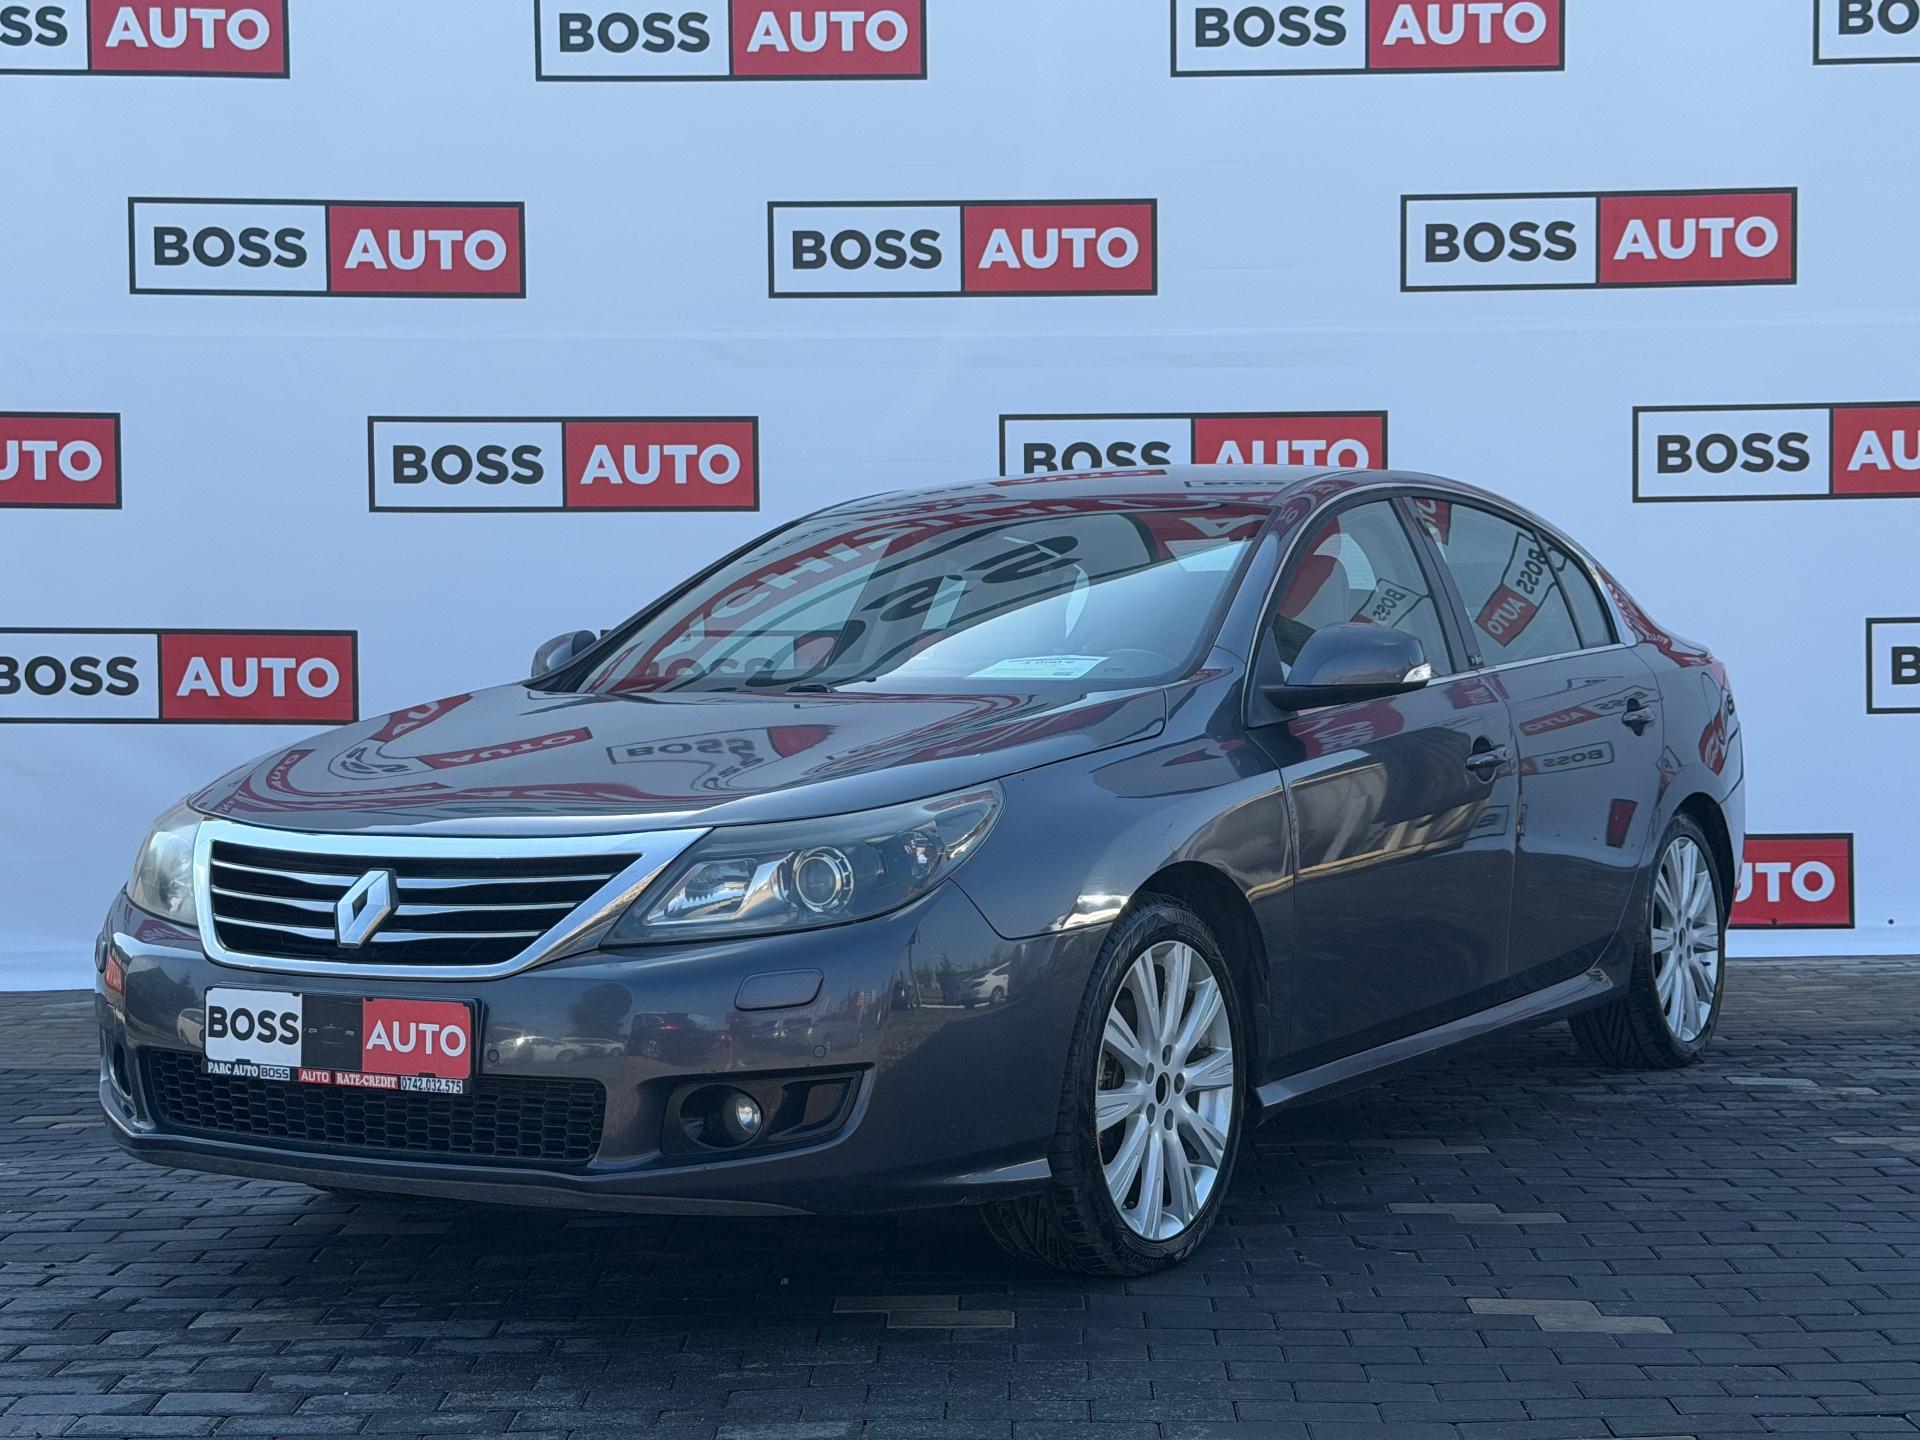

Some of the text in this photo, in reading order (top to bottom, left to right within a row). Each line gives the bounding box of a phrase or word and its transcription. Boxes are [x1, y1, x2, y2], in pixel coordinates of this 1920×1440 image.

[0, 6, 269, 50] SS AUTO
[558, 10, 908, 53] BOSS AUTO
[1195, 2, 1547, 48] BOSS AUTO
[1838, 0, 1920, 35] BO
[153, 226, 507, 271] BOSS AUTO
[792, 226, 1139, 270] BOSS AUTO
[1425, 216, 1779, 263] BOSS AUTO
[392, 443, 741, 485] BOSS AUTO
[1657, 429, 1920, 474] BOSS AU
[176, 656, 340, 698] AUTO
[208, 1005, 467, 1057] BOSS AUTO
[207, 1061, 232, 1075] PARC
[232, 1064, 259, 1077] AUTO
[261, 1066, 289, 1079] BOSS
[300, 1070, 329, 1083] AUTO
